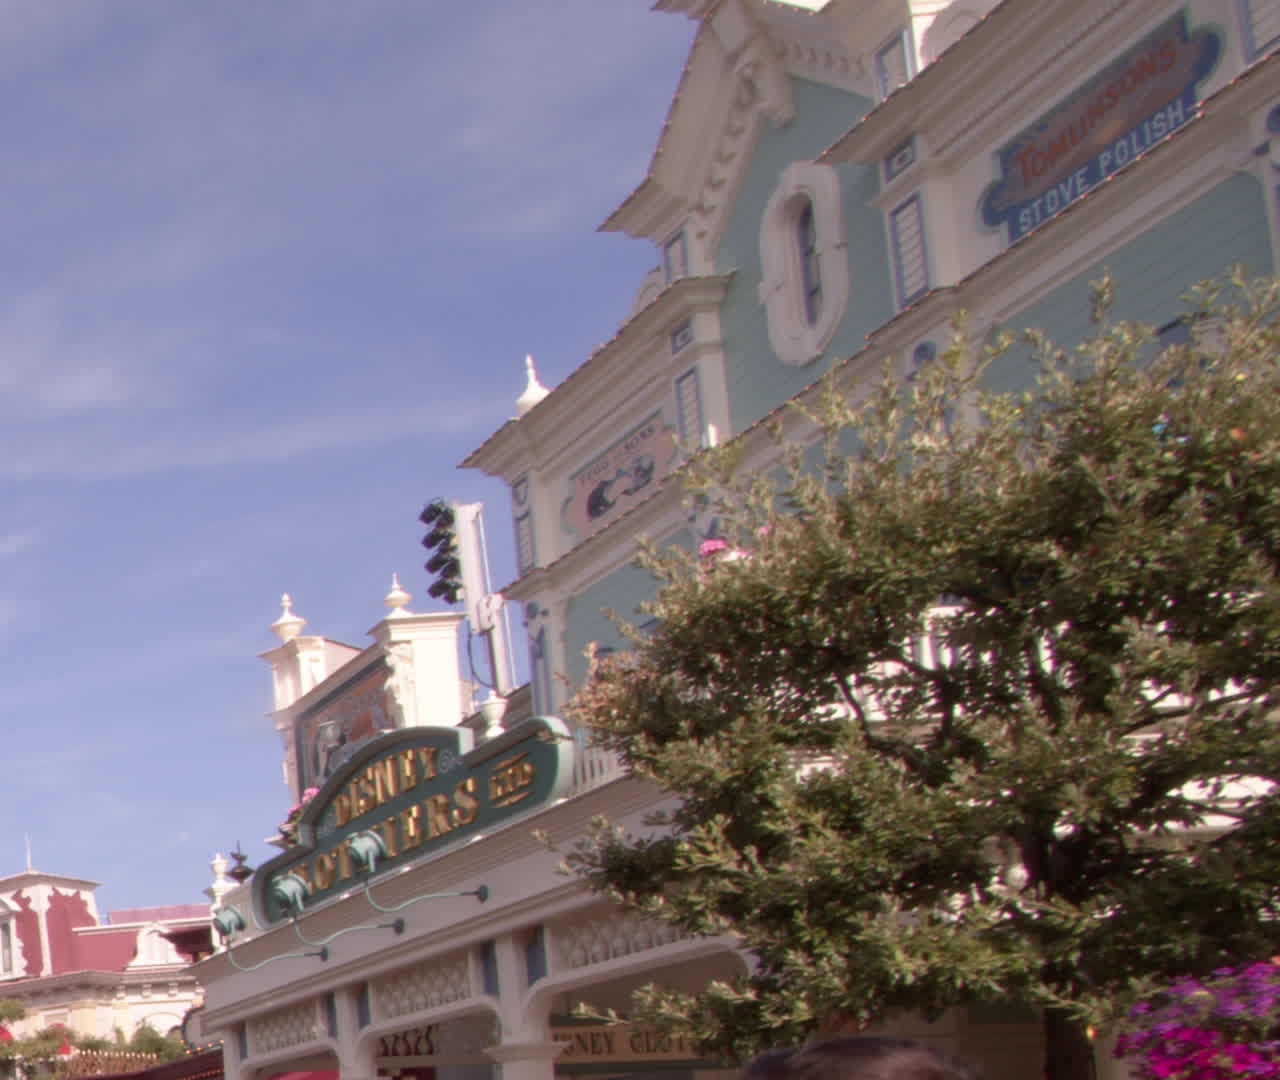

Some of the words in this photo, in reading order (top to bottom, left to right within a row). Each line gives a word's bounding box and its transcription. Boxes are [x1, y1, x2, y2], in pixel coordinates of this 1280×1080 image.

[1018, 167, 1090, 233] STOVE
[1097, 98, 1186, 178] POLISH
[332, 746, 438, 828] DISNEY
